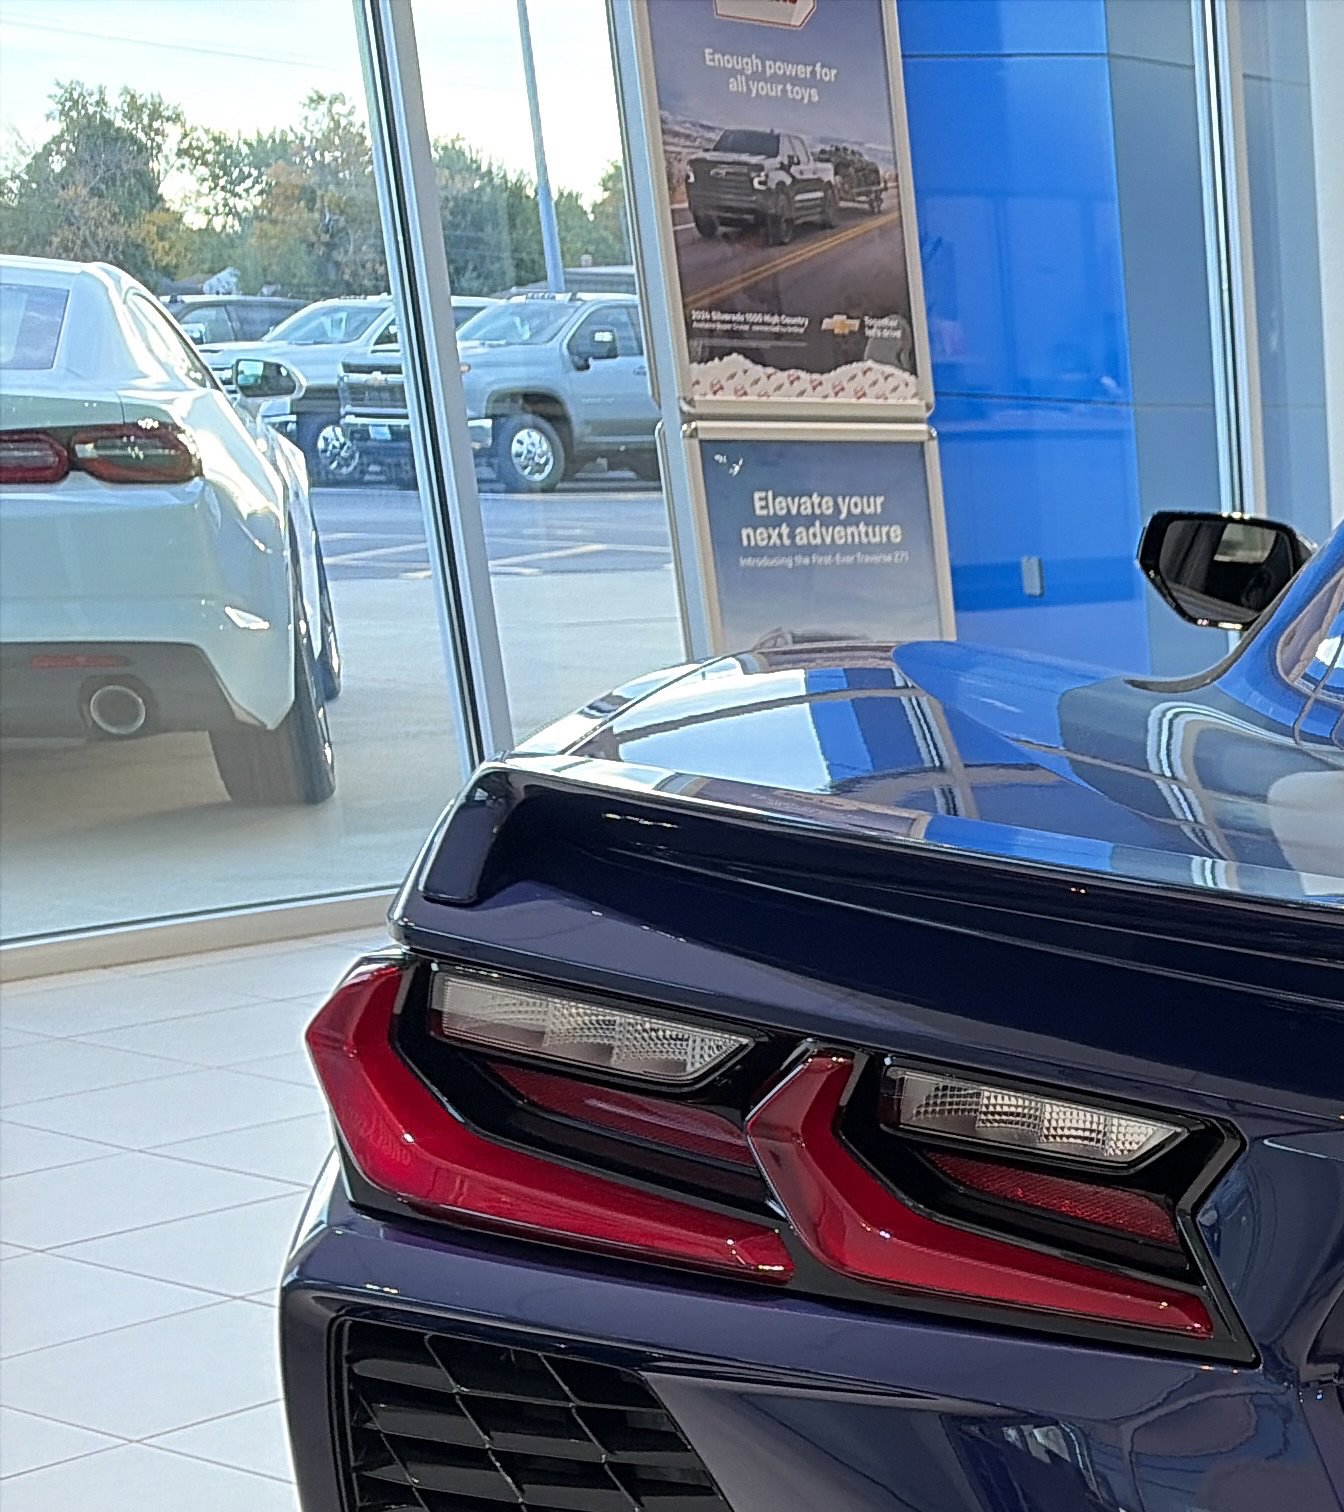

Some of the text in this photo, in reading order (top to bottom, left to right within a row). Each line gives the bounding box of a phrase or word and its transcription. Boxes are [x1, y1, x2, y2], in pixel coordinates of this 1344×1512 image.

[704, 48, 838, 83] Enough power for
[729, 75, 820, 104] all your toys
[753, 490, 885, 520] Elevate your
[741, 520, 903, 547] next adventure
